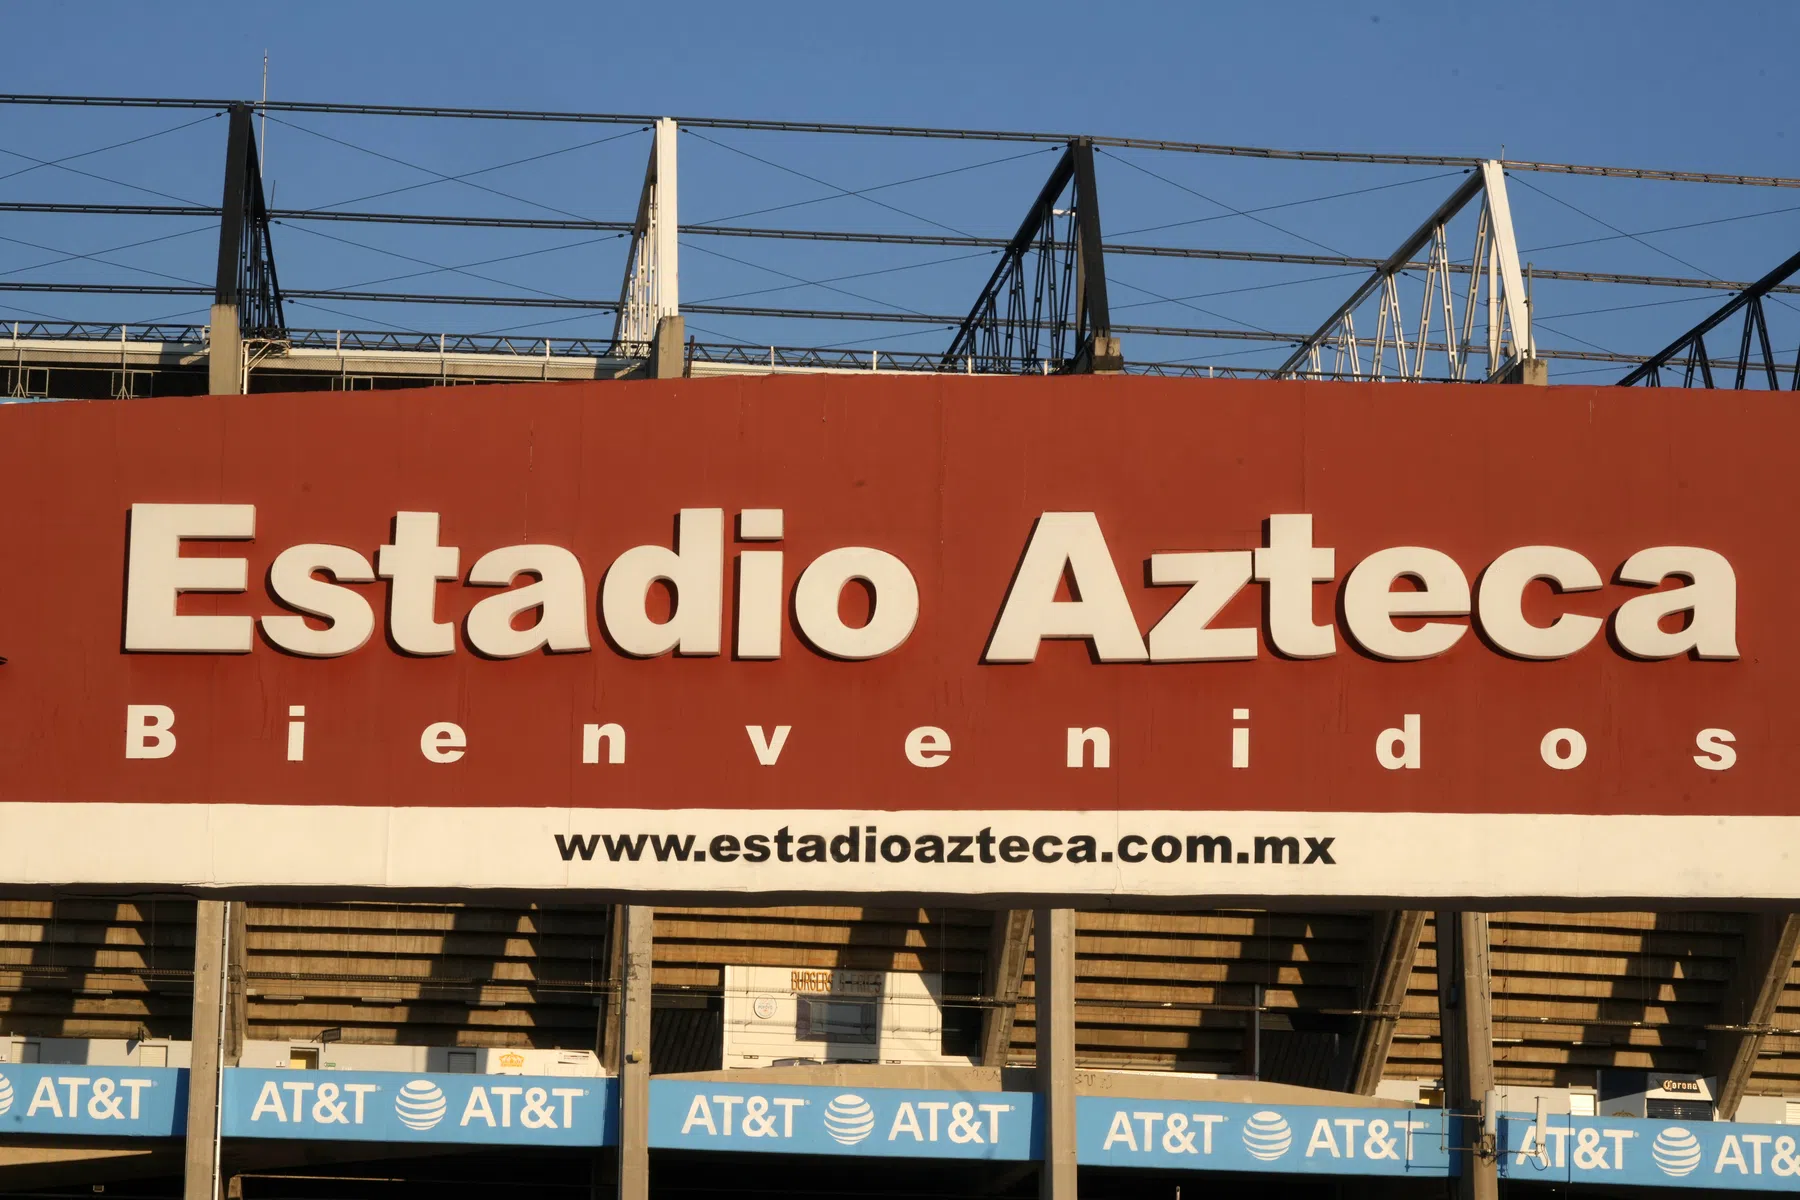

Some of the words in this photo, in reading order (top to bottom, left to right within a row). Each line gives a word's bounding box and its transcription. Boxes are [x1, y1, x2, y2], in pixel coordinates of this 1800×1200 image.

[126, 503, 919, 658] Estadio
[986, 510, 1740, 662] Azteca
[125, 704, 1738, 771] Bienvenidos
[555, 825, 1336, 865] www.estadioazteca.com.mx
[791, 970, 834, 992] BURGERS
[26, 1077, 152, 1120] AT&T
[250, 1081, 377, 1125] AT&T
[460, 1086, 585, 1130] AT&T
[1662, 1079, 1699, 1091] Corona
[681, 1094, 804, 1138] AT&T
[888, 1101, 1009, 1145] AT&T
[1103, 1111, 1223, 1155] AT&T
[1305, 1118, 1425, 1161] AT&T
